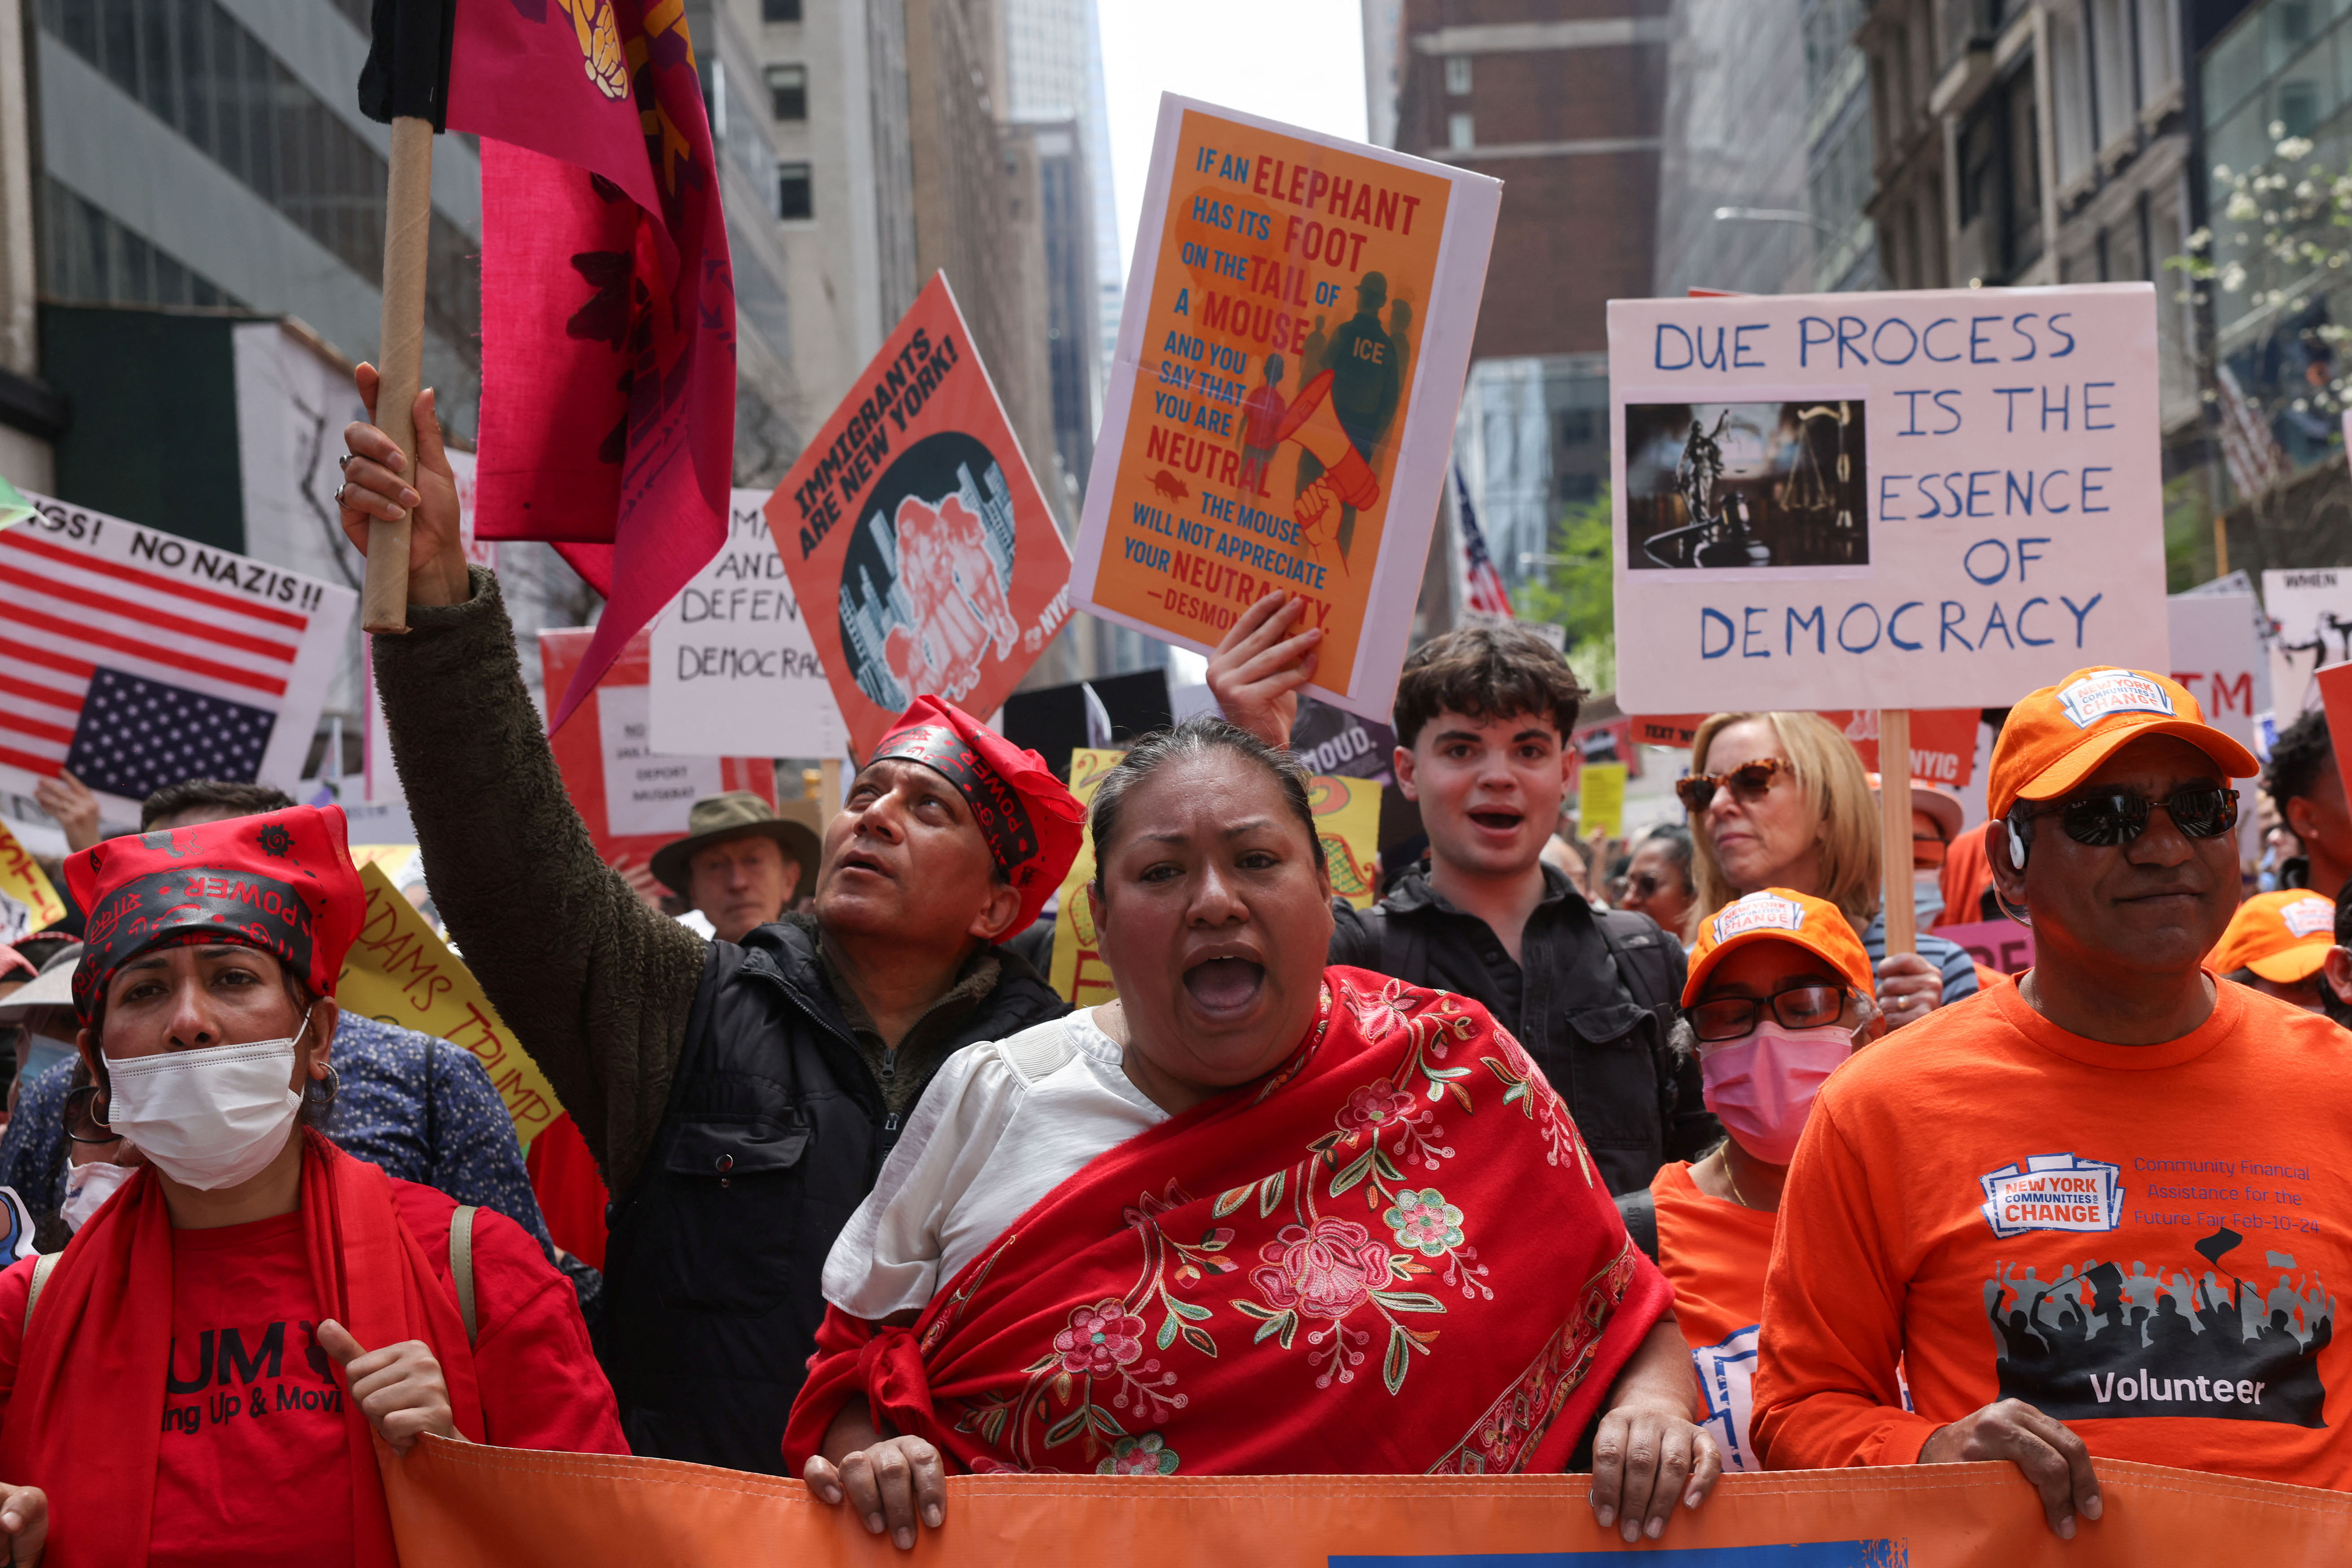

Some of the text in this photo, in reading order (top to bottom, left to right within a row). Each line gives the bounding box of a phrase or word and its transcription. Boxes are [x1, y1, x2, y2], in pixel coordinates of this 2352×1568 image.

[1196, 147, 1420, 236] IF AN ELEPHANT
[1192, 195, 1367, 272] HAS ITS FOOT
[1181, 242, 1341, 308] ON THE TAIL OF
[1174, 288, 1310, 357] A MOUSE
[1654, 313, 2075, 372] DUE PROCESS
[1163, 330, 1247, 374] AND YOU
[1352, 337, 1385, 364] ICE
[1158, 361, 1247, 408] SAY THAT
[793, 327, 932, 520] IMMIGRANTS
[1154, 391, 1234, 438] YOU ARE
[1893, 382, 2116, 437] IS THE
[798, 335, 959, 561] ARE NEW YORK!
[1146, 426, 1271, 499] NEUTRAL
[1880, 467, 2113, 521] ESSENCE
[1201, 491, 1302, 547] THE MOUSE
[715, 552, 786, 580] AND
[1132, 502, 1327, 590] WILL NOT APPRECIATE
[1964, 538, 2051, 586] OF
[130, 532, 185, 568] NO
[192, 551, 324, 612] NAZIS!!
[1124, 536, 1332, 635] YOUR NEUTRATY.
[2283, 570, 2337, 590] WHEN
[1701, 592, 2102, 660] DEMOCRACY
[2077, 679, 2153, 698] NEW YORK
[2082, 687, 2149, 704] COMMUNITIES
[2082, 693, 2161, 716] CHANGE
[1645, 724, 1674, 740] TEXT
[1909, 747, 1959, 781] NYIC
[960, 749, 1023, 833] POWER
[183, 876, 298, 927] POWER
[1725, 901, 1787, 922] NEW YORK
[1725, 913, 1789, 935] CHANGE
[2005, 1177, 2097, 1194] NEW YORK
[2135, 1156, 2310, 1181] Community Financial
[2005, 1193, 2092, 1204] COMMUNITIES
[2005, 1204, 2101, 1223] CHANGE
[2148, 1184, 2302, 1206] Assistance for the
[2135, 1210, 2321, 1234] Future Fair Feb-10-24
[210, 1392, 241, 1425] Up
[249, 1387, 268, 1418] &
[276, 1384, 344, 1413] Movi
[2089, 1368, 2266, 1406] Volunteer
